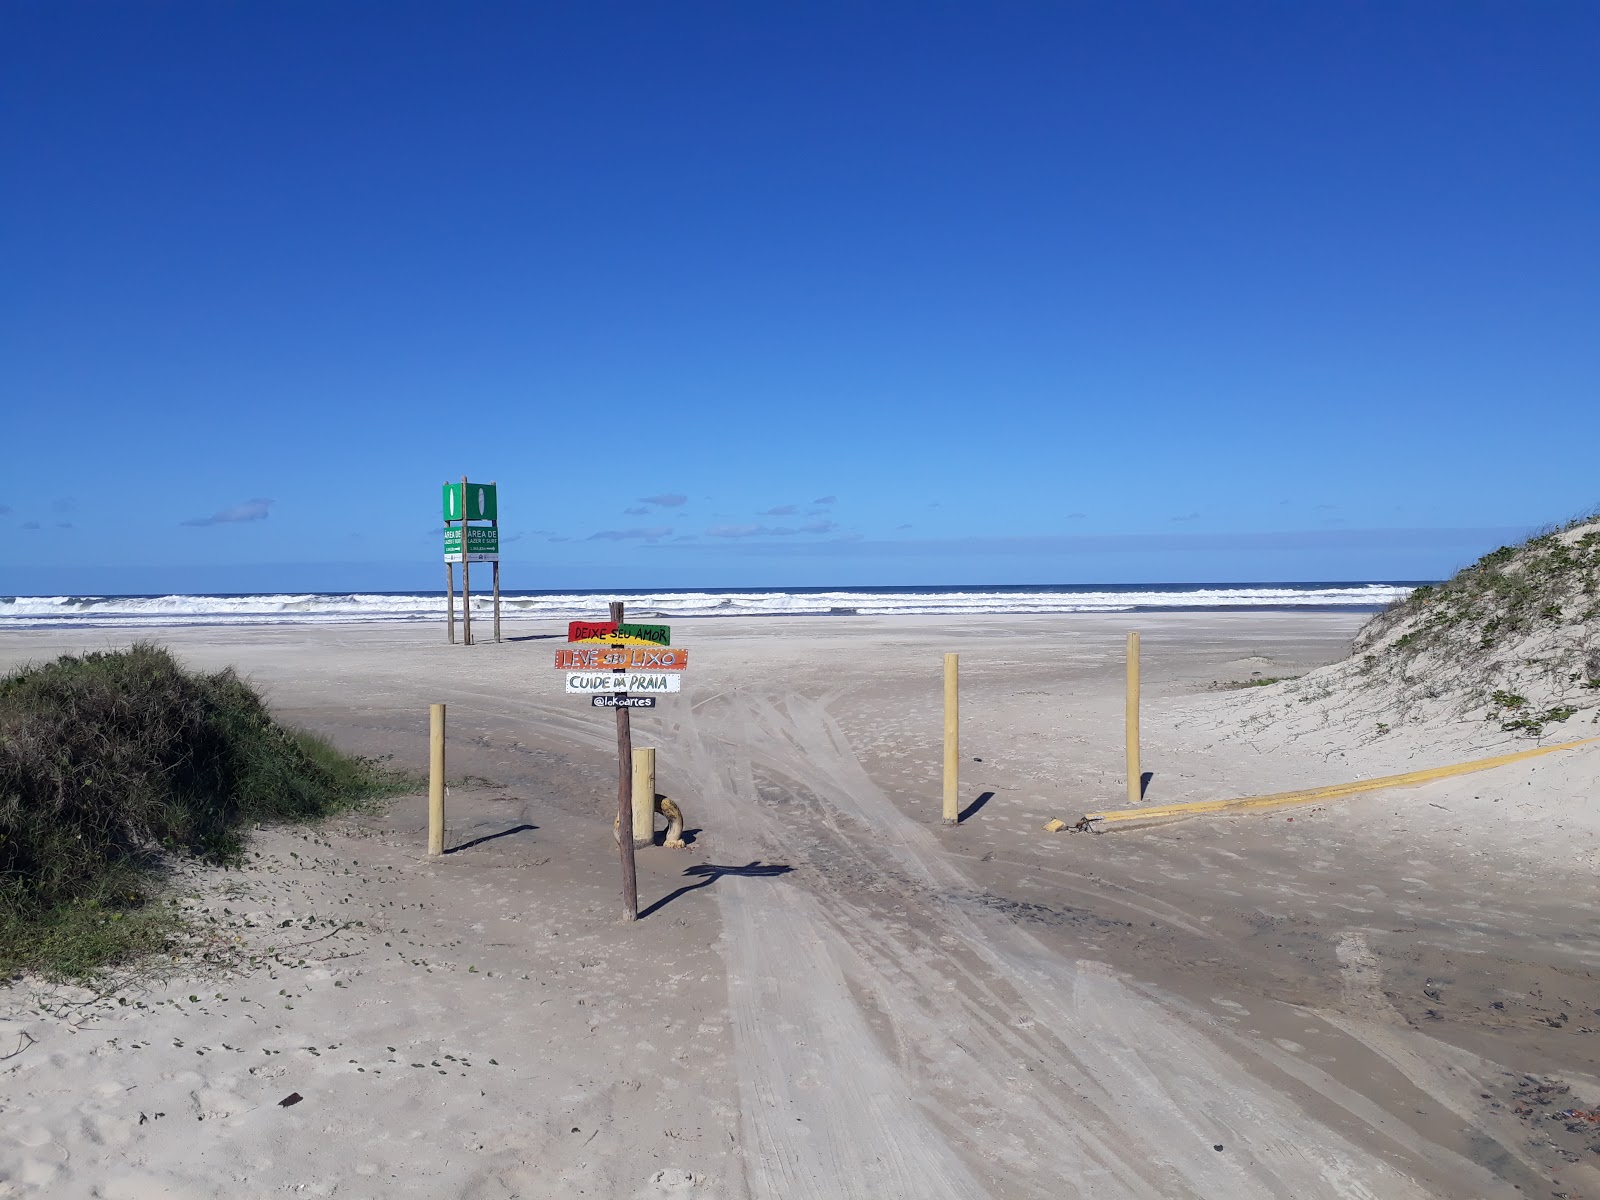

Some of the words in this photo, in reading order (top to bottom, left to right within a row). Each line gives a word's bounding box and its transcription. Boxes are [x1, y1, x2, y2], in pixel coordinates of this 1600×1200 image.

[468, 528, 486, 538] ÁREA
[575, 628, 606, 640] DEIXE
[610, 629, 630, 639] SEU
[635, 629, 667, 641] AMOR
[562, 650, 598, 666] LEVE
[603, 654, 627, 665] SEU
[631, 650, 675, 666] LIXO
[570, 676, 611, 689] CUIDE
[614, 677, 626, 688] DA
[629, 676, 667, 690] PRAIA
